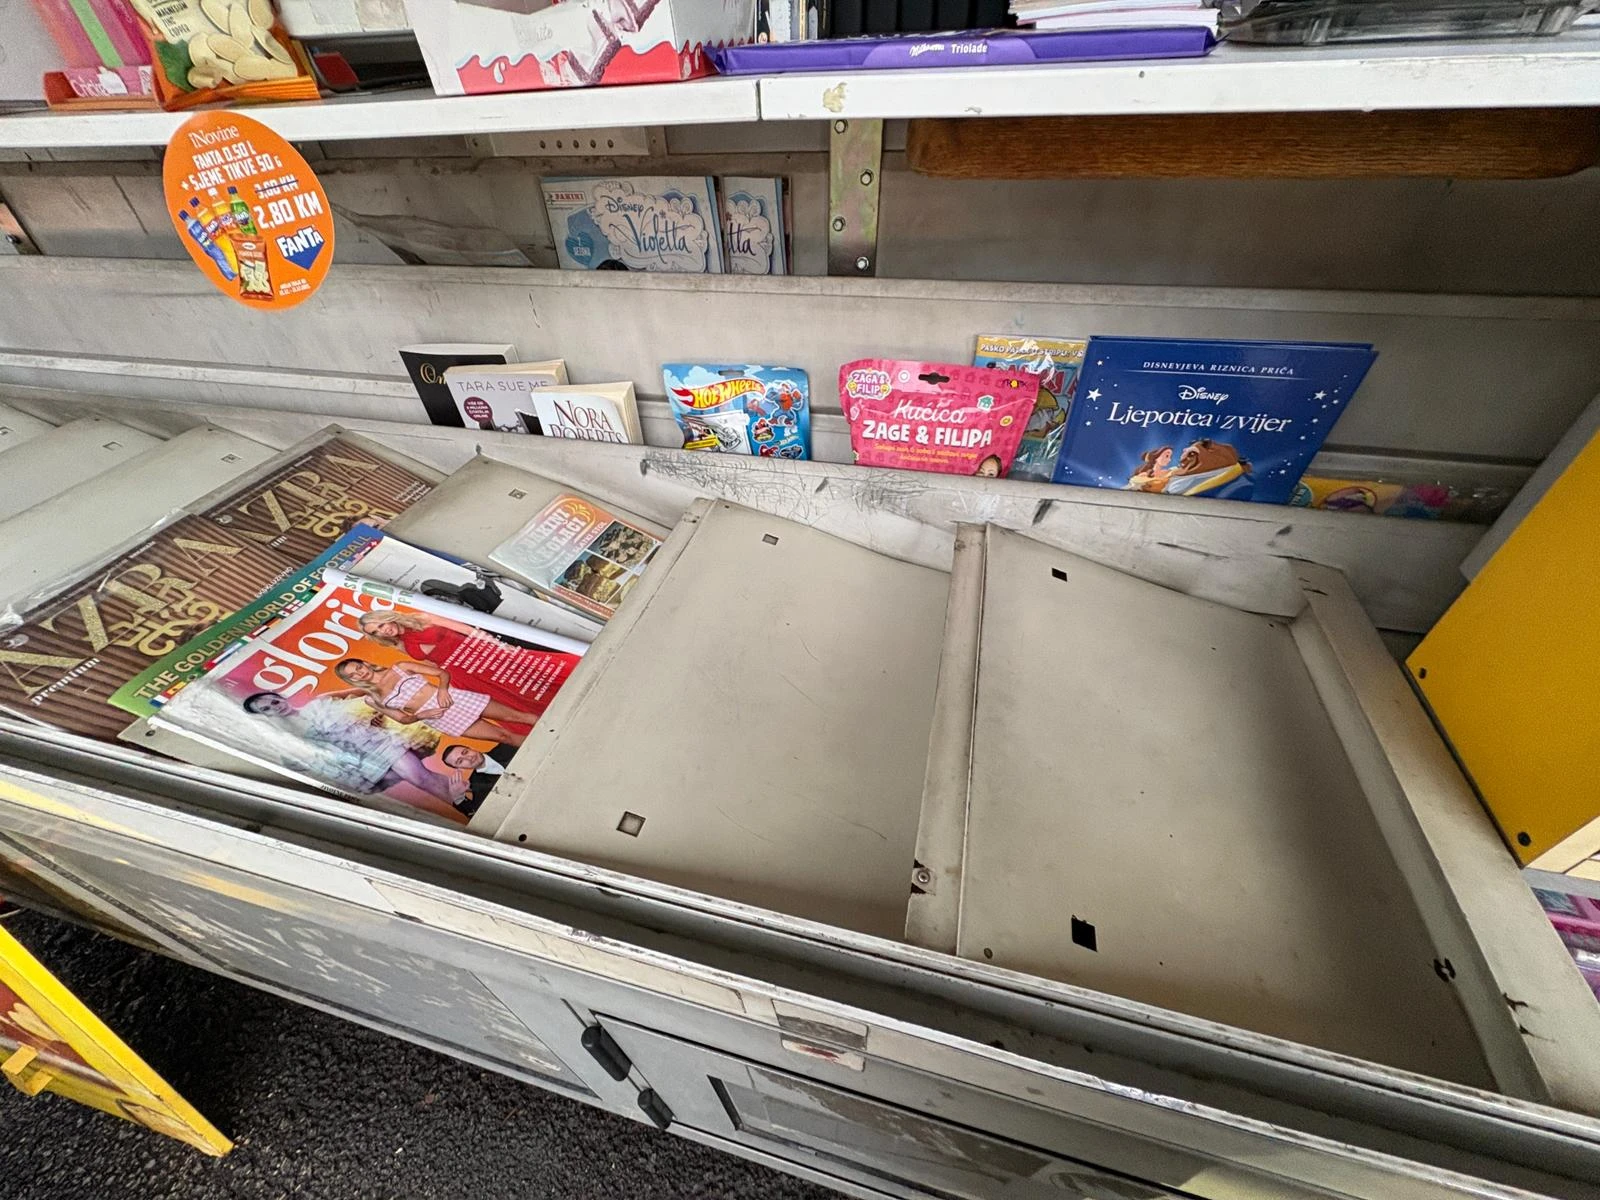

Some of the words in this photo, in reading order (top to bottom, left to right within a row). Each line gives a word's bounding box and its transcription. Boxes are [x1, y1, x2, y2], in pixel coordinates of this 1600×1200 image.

[951, 42, 988, 54] Triolade
[188, 125, 240, 148] iNovine
[192, 148, 224, 170] FANTA
[222, 142, 247, 161] 0,50
[188, 167, 226, 192] SJEME
[224, 157, 258, 180] TIKVE
[255, 153, 275, 172] 50
[280, 173, 299, 193] KM
[253, 198, 296, 229] 2,80
[293, 191, 324, 219] KM
[554, 192, 586, 202] PANINI
[276, 225, 324, 258] FANTA
[608, 205, 696, 264] Violetta
[853, 374, 878, 384] ZAGA
[1143, 361, 1206, 372] DISNEYJEVA
[1210, 364, 1256, 374] RIZNICA
[1260, 365, 1295, 376] PRIČA
[456, 381, 494, 392] TARA
[498, 381, 526, 392] SUE
[693, 388, 721, 409] HOT
[856, 384, 880, 394] FILIP
[552, 399, 614, 431] NORA
[893, 399, 966, 424] Kućica
[1106, 402, 1214, 428] Ljepotica
[1220, 414, 1292, 434] zvijer
[862, 420, 911, 443] ZAGE
[915, 426, 928, 445] &
[934, 427, 993, 448] FILIPA
[539, 516, 588, 558] KOLAČI
[0, 537, 250, 699] AZRA
[133, 670, 180, 698] THE
[174, 626, 244, 675] GOLDEN
[240, 591, 297, 629] WORLD
[292, 575, 314, 594] OF
[310, 534, 374, 578] FOOTBALL
[253, 590, 396, 700] gloria
[30, 657, 100, 706] premium
